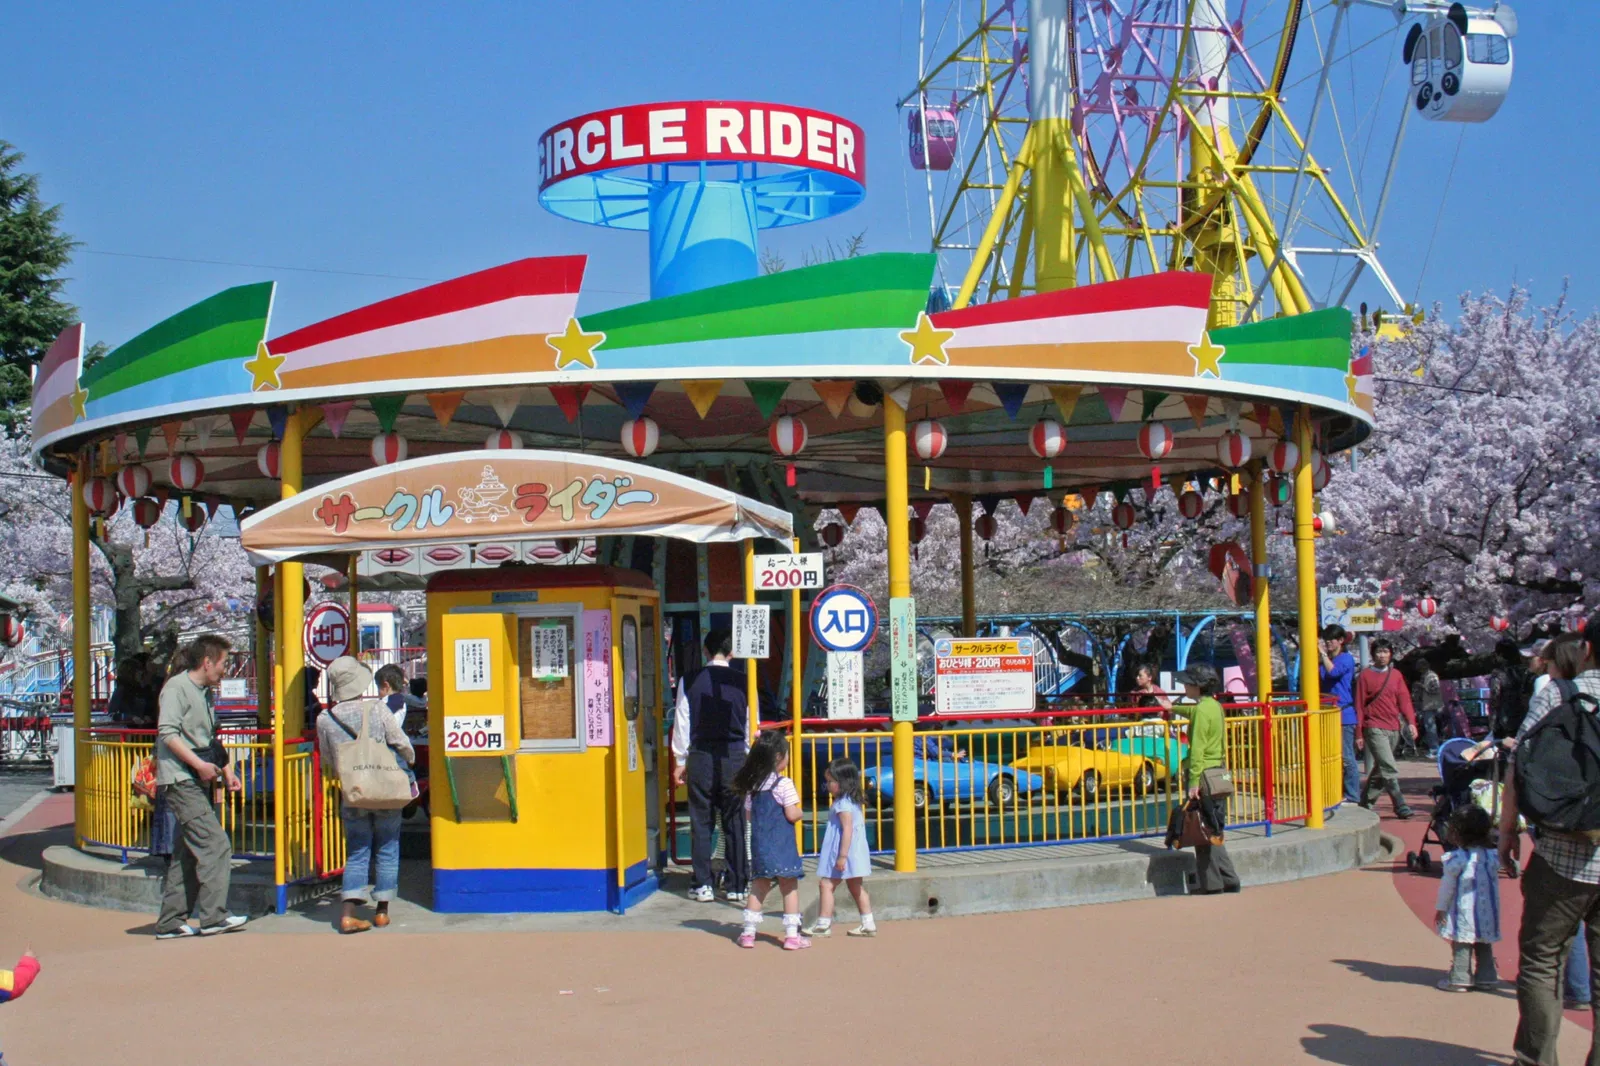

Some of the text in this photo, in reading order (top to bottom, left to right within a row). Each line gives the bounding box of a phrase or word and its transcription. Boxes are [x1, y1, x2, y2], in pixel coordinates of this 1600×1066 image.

[538, 108, 855, 188] CIRCLE RIDER
[317, 478, 655, 534] サークル ライダー
[767, 557, 808, 568] お一人様
[762, 569, 818, 587] 200円
[822, 609, 865, 633] 入口
[312, 623, 345, 648] 出口
[955, 643, 1015, 654] サークルライダー
[453, 718, 492, 730] お一人様
[447, 730, 502, 749] 200円
